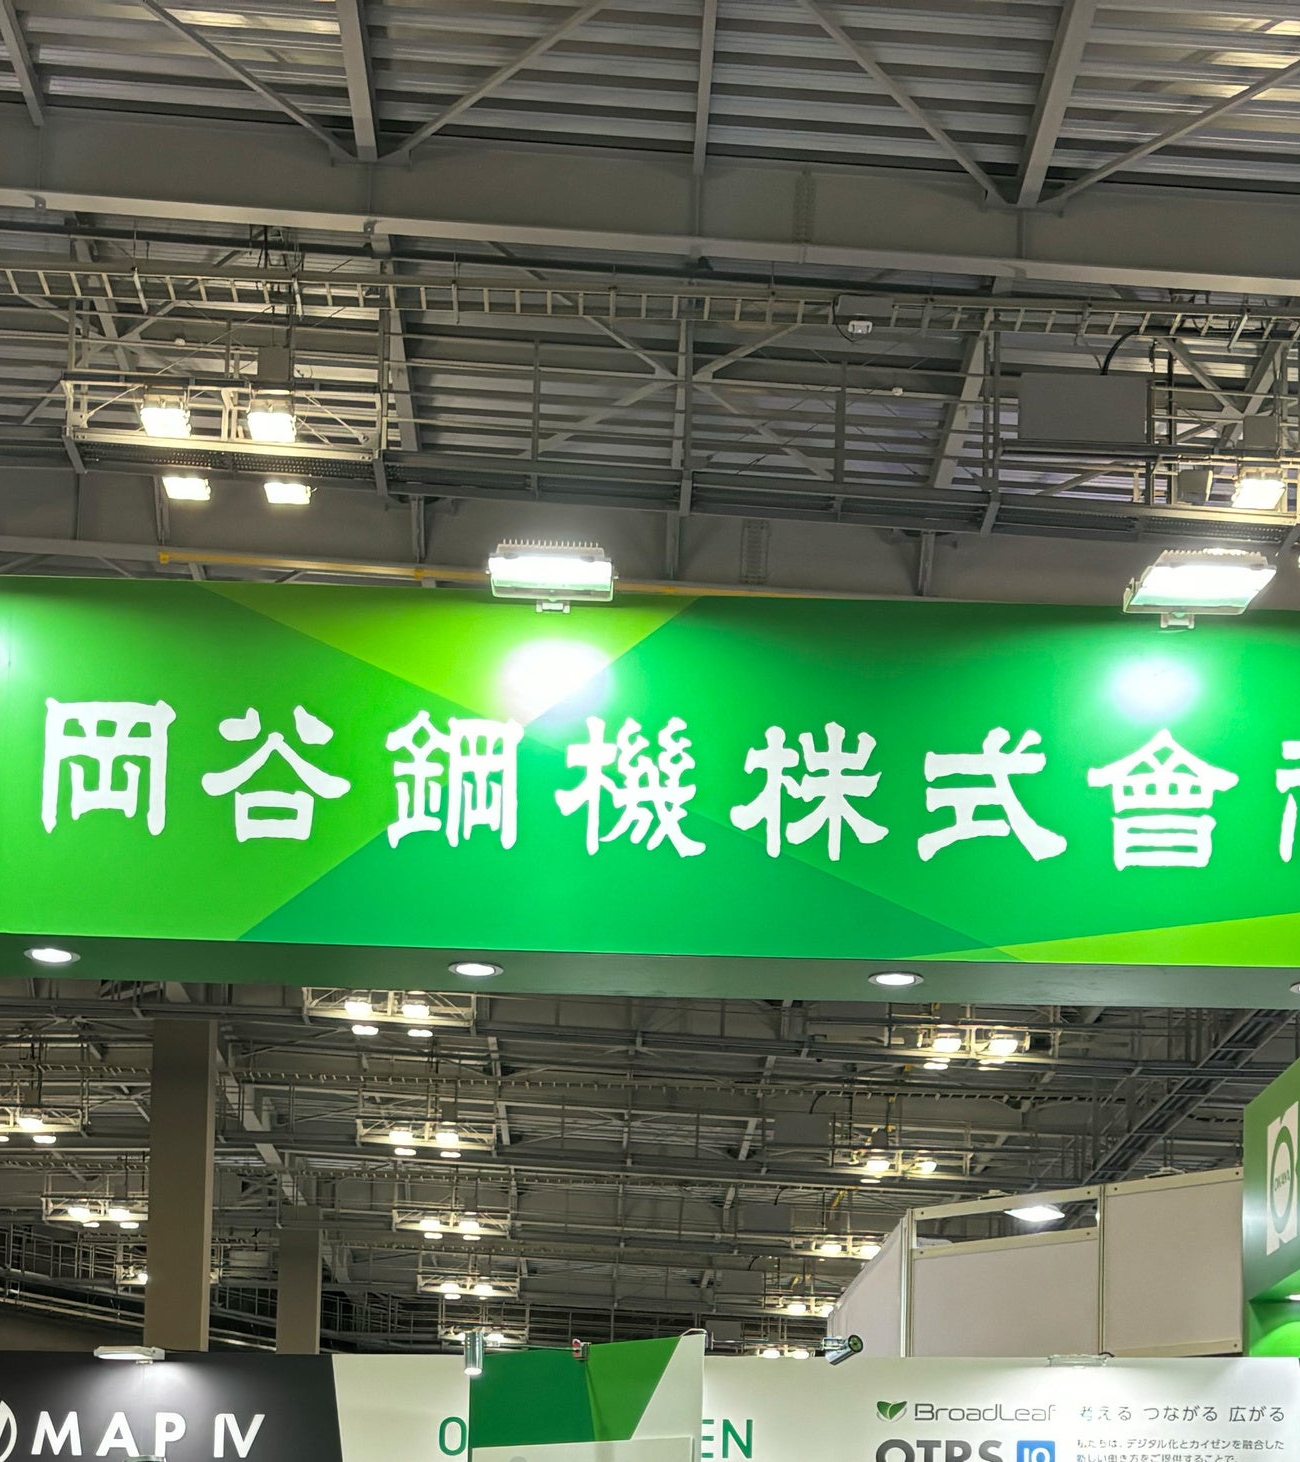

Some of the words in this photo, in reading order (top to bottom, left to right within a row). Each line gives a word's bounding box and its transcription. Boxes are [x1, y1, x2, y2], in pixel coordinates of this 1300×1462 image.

[1143, 1405, 1218, 1422] つながる
[1228, 1405, 1285, 1422] 広がる
[30, 1410, 188, 1458] MAP
